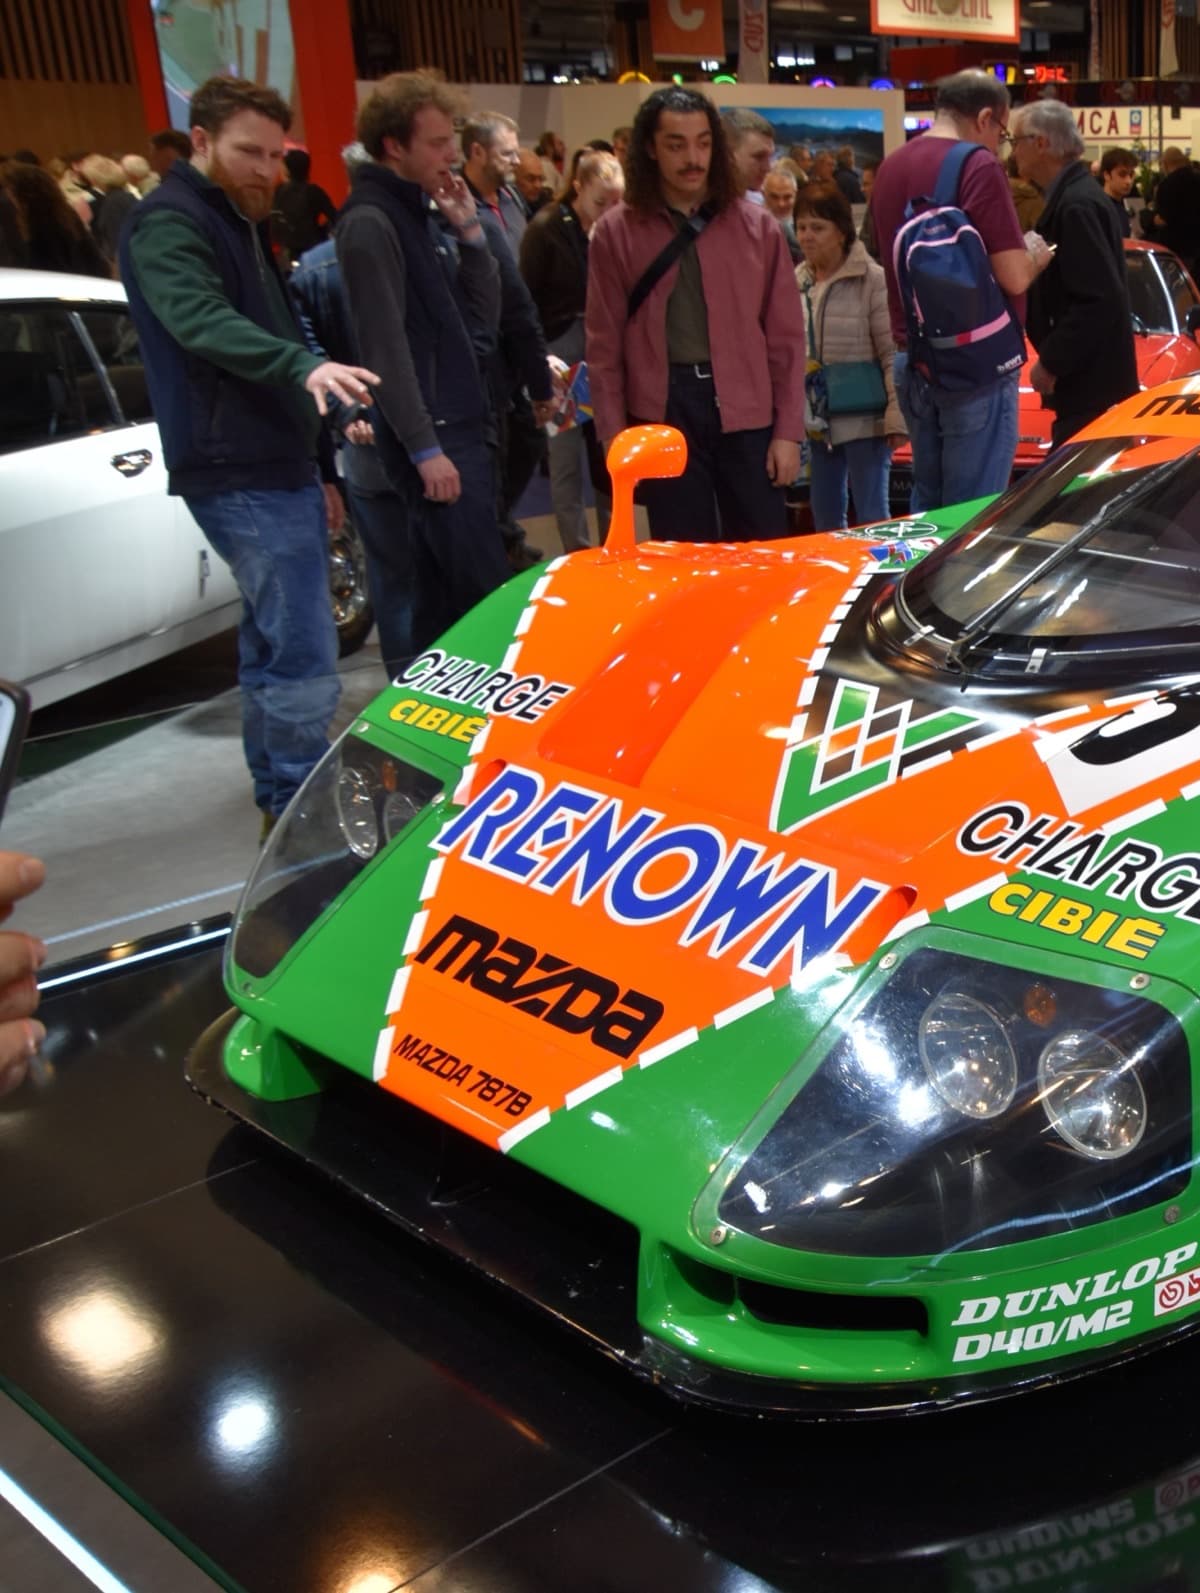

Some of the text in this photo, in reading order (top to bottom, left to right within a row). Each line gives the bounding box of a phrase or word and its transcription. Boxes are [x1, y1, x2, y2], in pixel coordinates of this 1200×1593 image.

[395, 651, 573, 722] CHARGE
[430, 763, 889, 976] RENOWN
[393, 1034, 533, 1117] MAZDA 787B
[951, 1241, 1199, 1326] DUNLOP
[952, 1300, 1134, 1362] D40/M2
